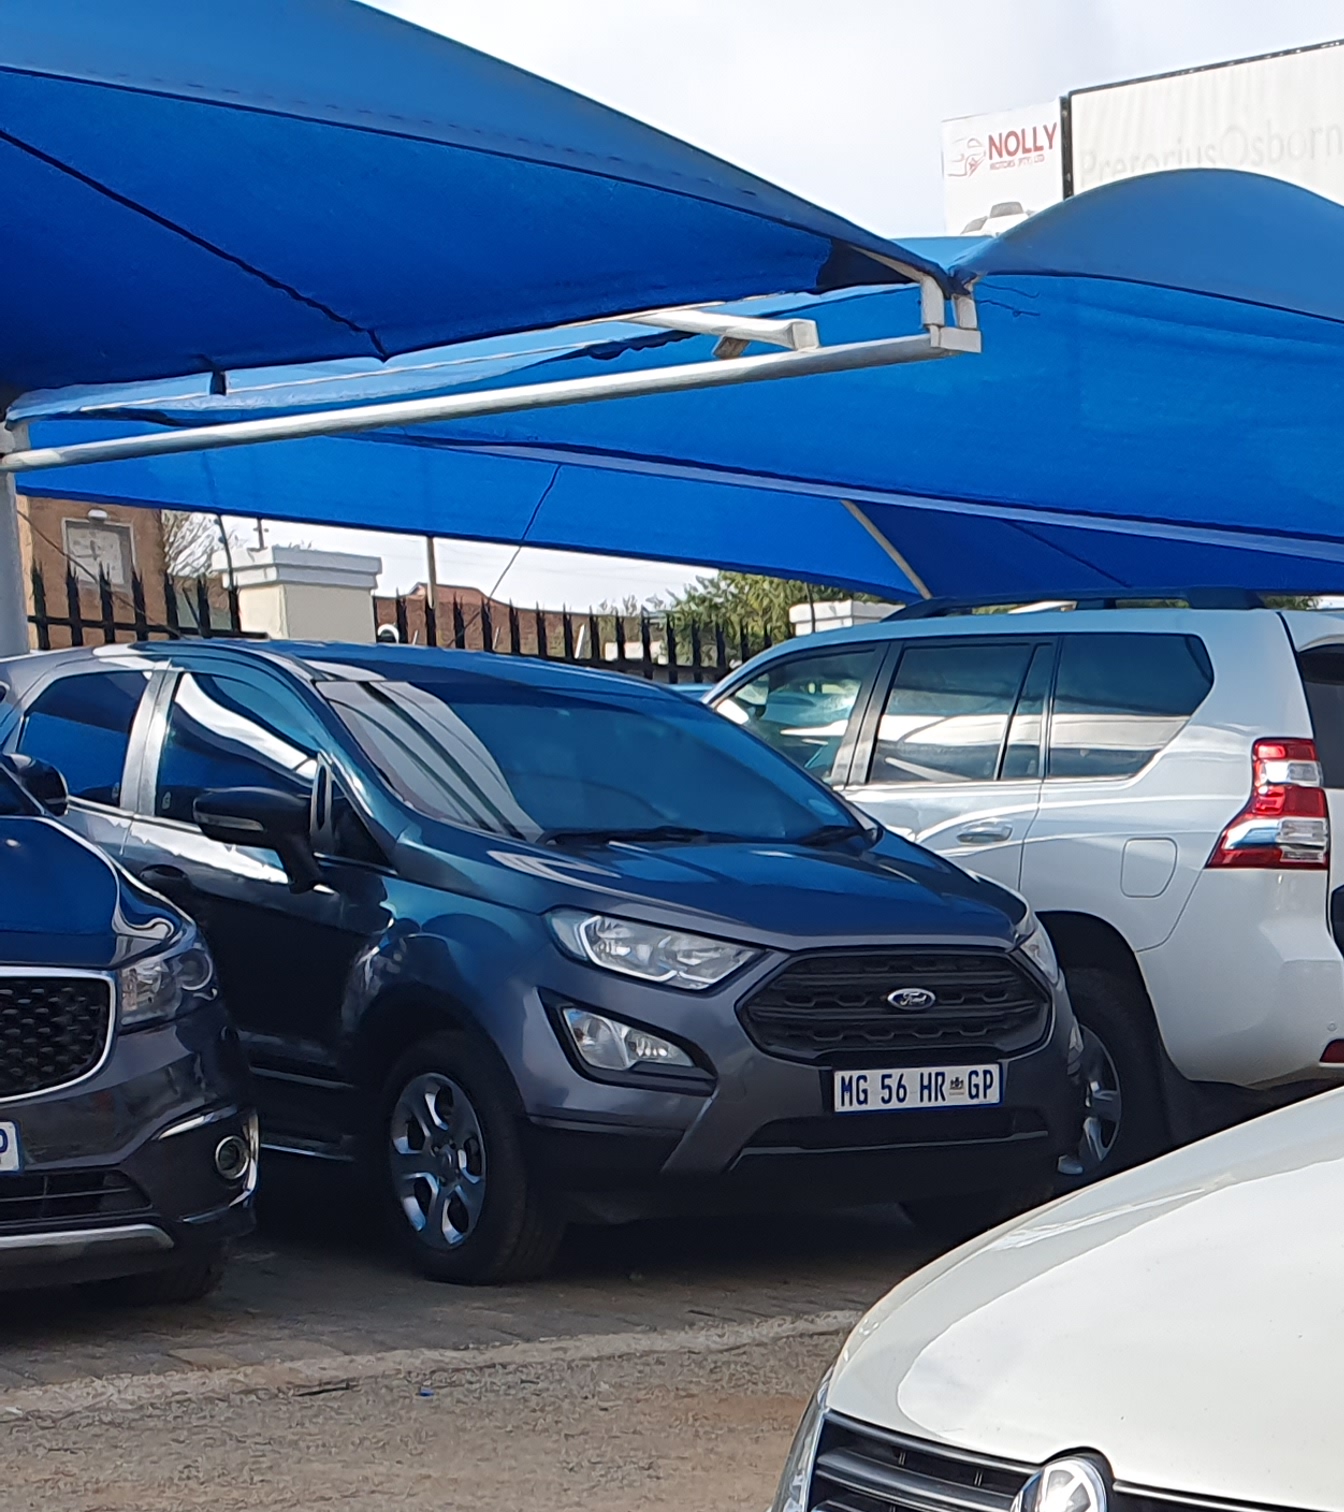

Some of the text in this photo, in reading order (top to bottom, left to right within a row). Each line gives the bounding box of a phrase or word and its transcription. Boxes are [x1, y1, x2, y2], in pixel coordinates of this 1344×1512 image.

[989, 122, 1057, 160] NOLLY
[841, 1069, 994, 1107] MG 56 HR GP
